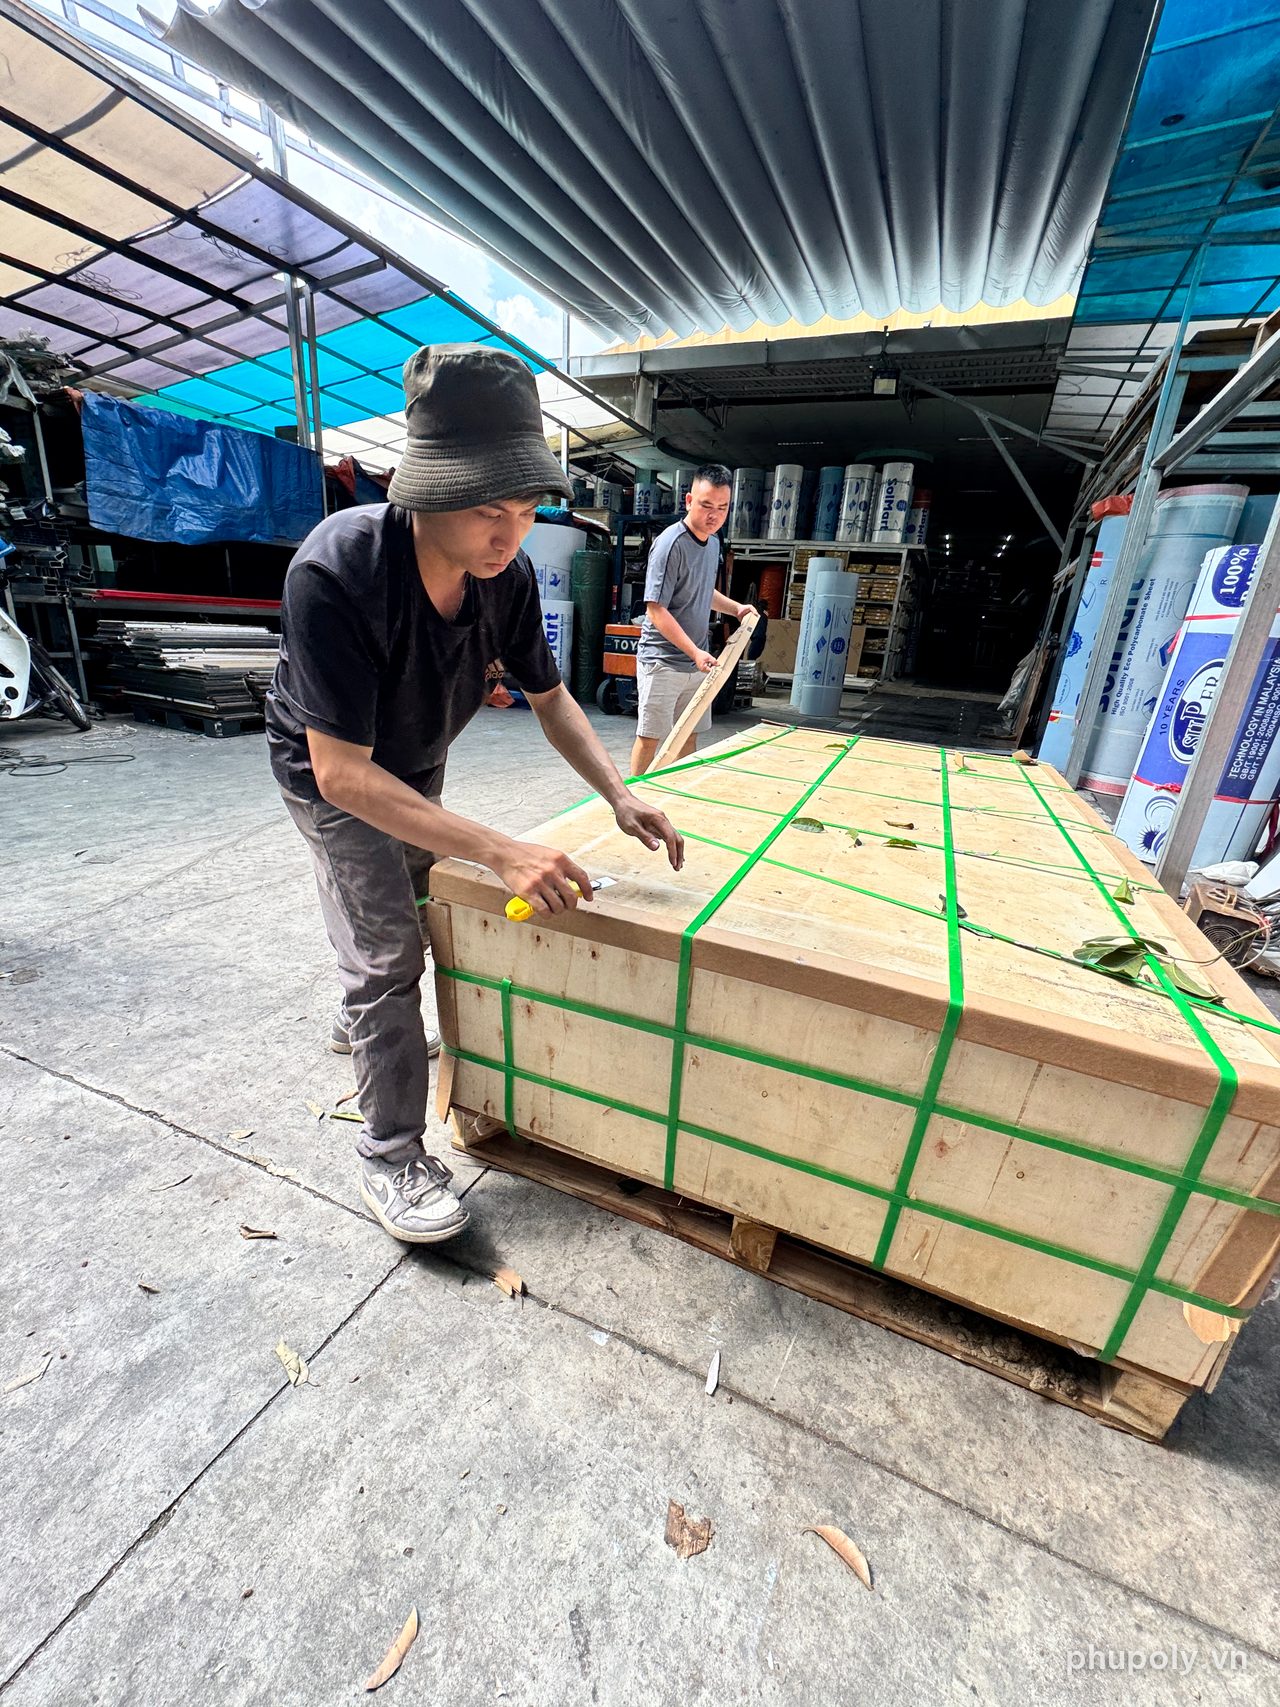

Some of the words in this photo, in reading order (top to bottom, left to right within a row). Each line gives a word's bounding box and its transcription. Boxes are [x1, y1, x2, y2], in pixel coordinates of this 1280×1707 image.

[880, 477, 898, 531] SolMart
[1220, 547, 1250, 595] 100%
[614, 639, 638, 651] TOY
[1111, 699, 1121, 716] High
[1116, 672, 1129, 698] Quality
[1124, 657, 1132, 671] Eco
[1128, 602, 1149, 656] Polycarbonate
[1144, 578, 1156, 601] Sheet
[1257, 656, 1280, 706] MALAYSIA
[1160, 723, 1168, 735] 10
[1164, 679, 1185, 721] YEARS
[1254, 705, 1265, 717] IN
[1228, 716, 1260, 780] TECHNOLOGY
[1239, 761, 1252, 780] GB/T
[1247, 761, 1260, 781] GB/T
